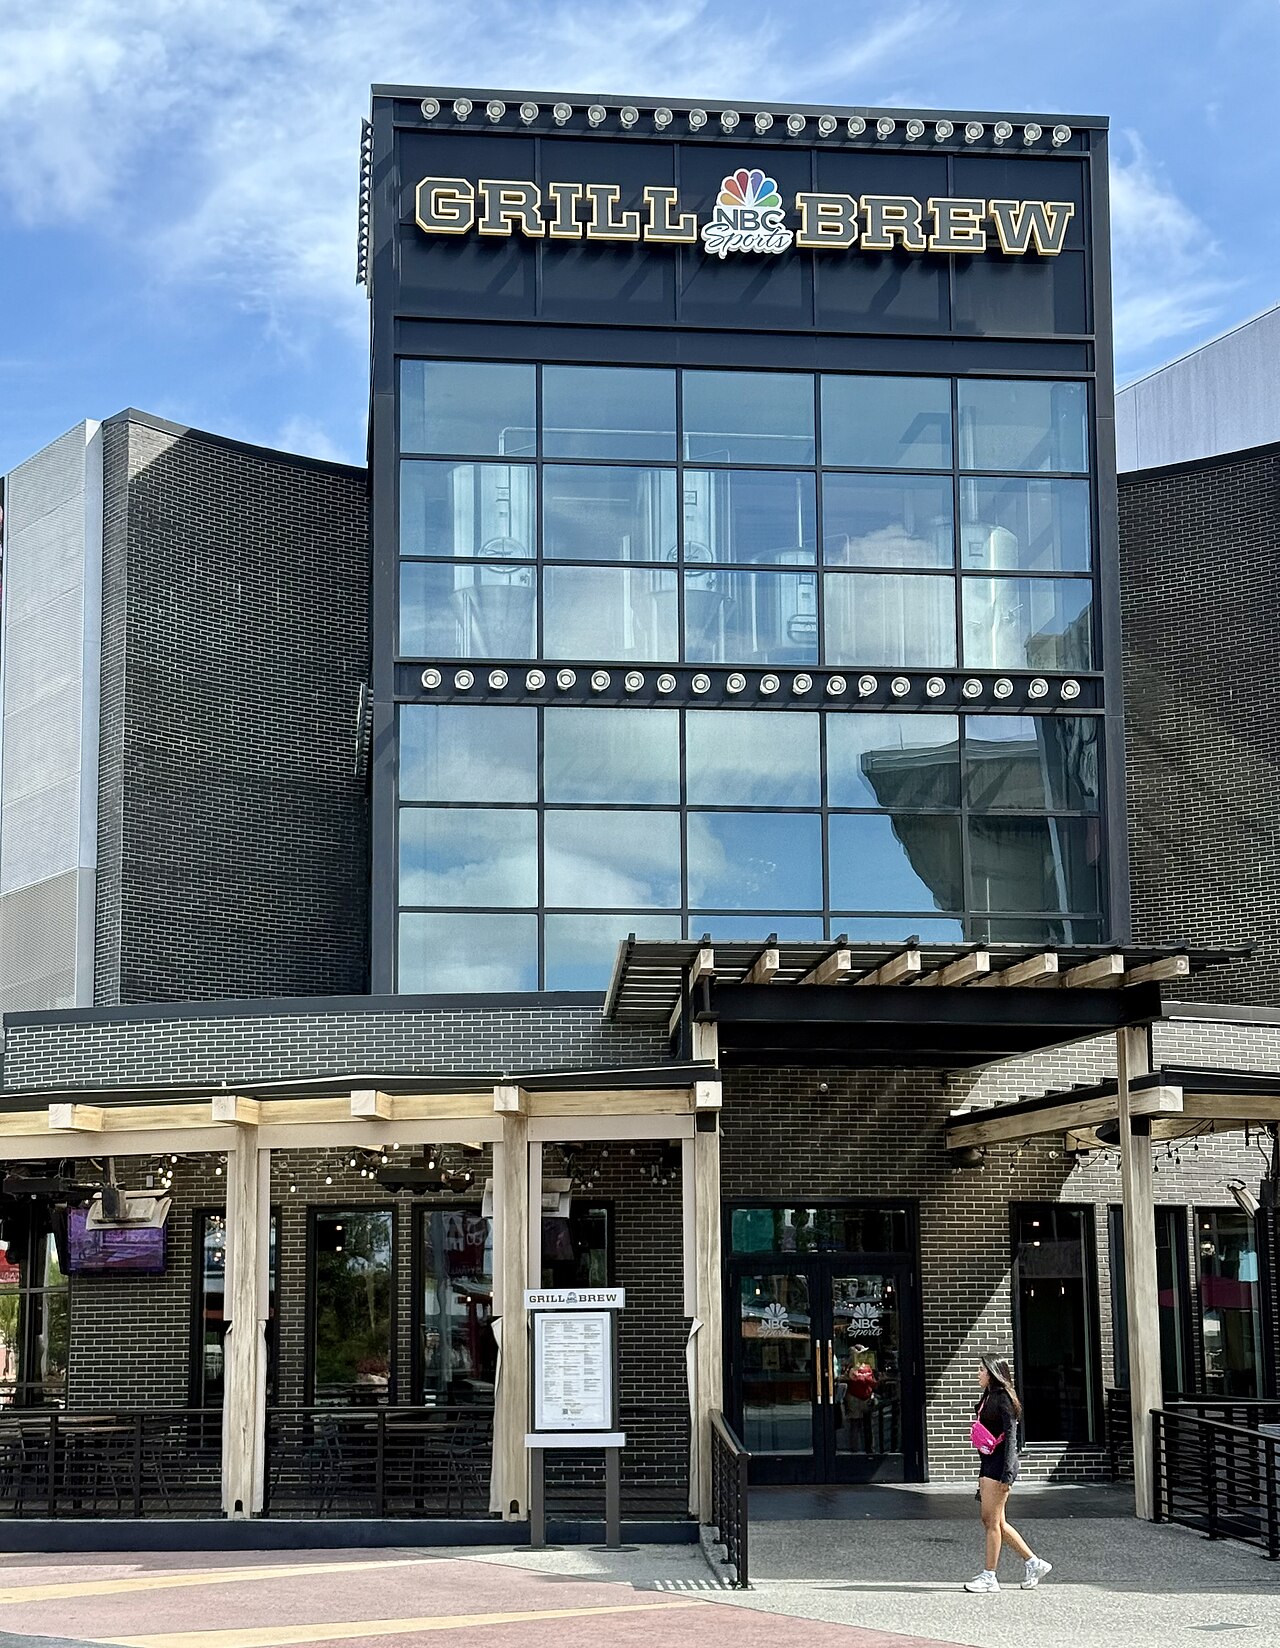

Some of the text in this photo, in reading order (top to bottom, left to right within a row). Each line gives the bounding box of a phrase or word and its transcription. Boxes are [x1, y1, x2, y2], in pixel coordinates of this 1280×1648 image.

[415, 176, 1075, 256] GRILL BREW
[716, 208, 783, 231] NBC
[705, 223, 791, 252] Sports
[529, 1294, 566, 1303] GRILL
[578, 1293, 617, 1303] BREW
[761, 1319, 790, 1329] NBC
[852, 1319, 880, 1329] NBC
[757, 1326, 792, 1338] Sports
[847, 1326, 883, 1338] Sports
